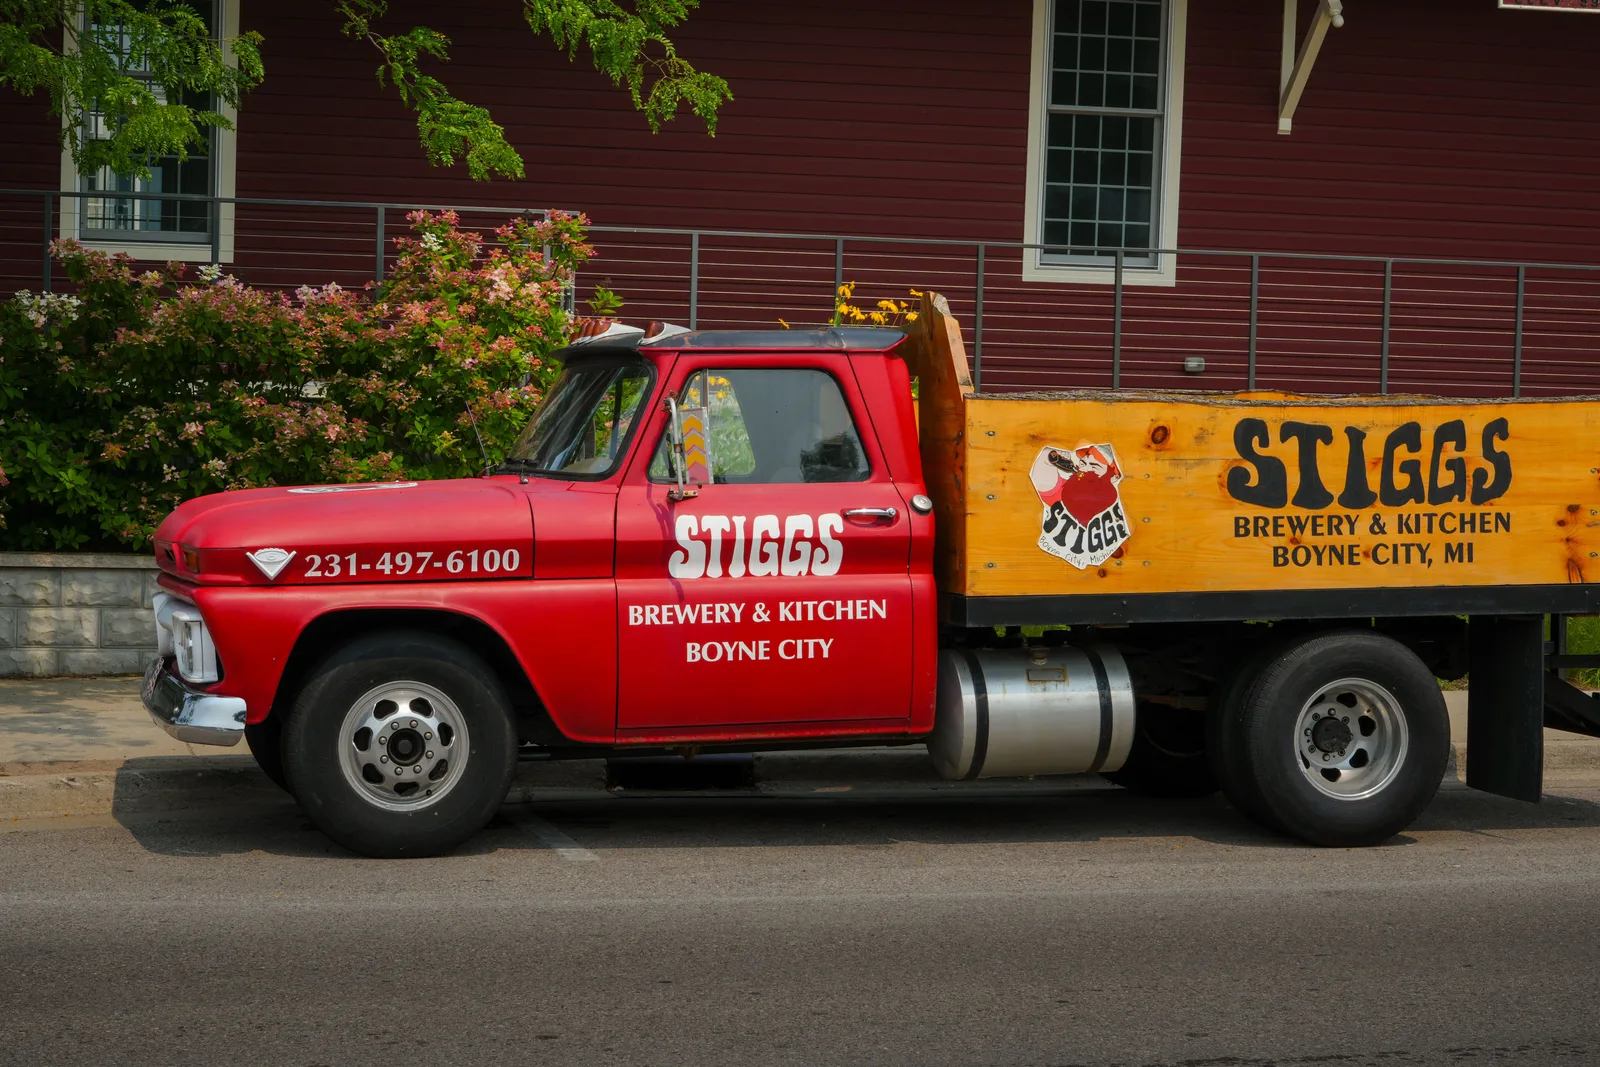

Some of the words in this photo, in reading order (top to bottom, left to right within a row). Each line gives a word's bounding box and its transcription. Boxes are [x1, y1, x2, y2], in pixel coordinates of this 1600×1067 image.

[1227, 417, 1512, 509] STIGGS
[1043, 501, 1128, 554] STIGGS
[1234, 514, 1360, 538] BREWERY
[1368, 512, 1387, 535] &
[1397, 511, 1511, 534] KITCHEN
[668, 513, 844, 579] STIGGS
[1273, 543, 1361, 567] BOYNE
[1371, 542, 1433, 569] CITY,
[1444, 542, 1474, 563] MI
[304, 548, 520, 578] 231-497-6100
[628, 602, 746, 626] BREWERY
[752, 602, 771, 623] &
[779, 599, 888, 622] KITCHEN
[686, 640, 771, 662] BOYNE
[778, 638, 835, 660] CITY
